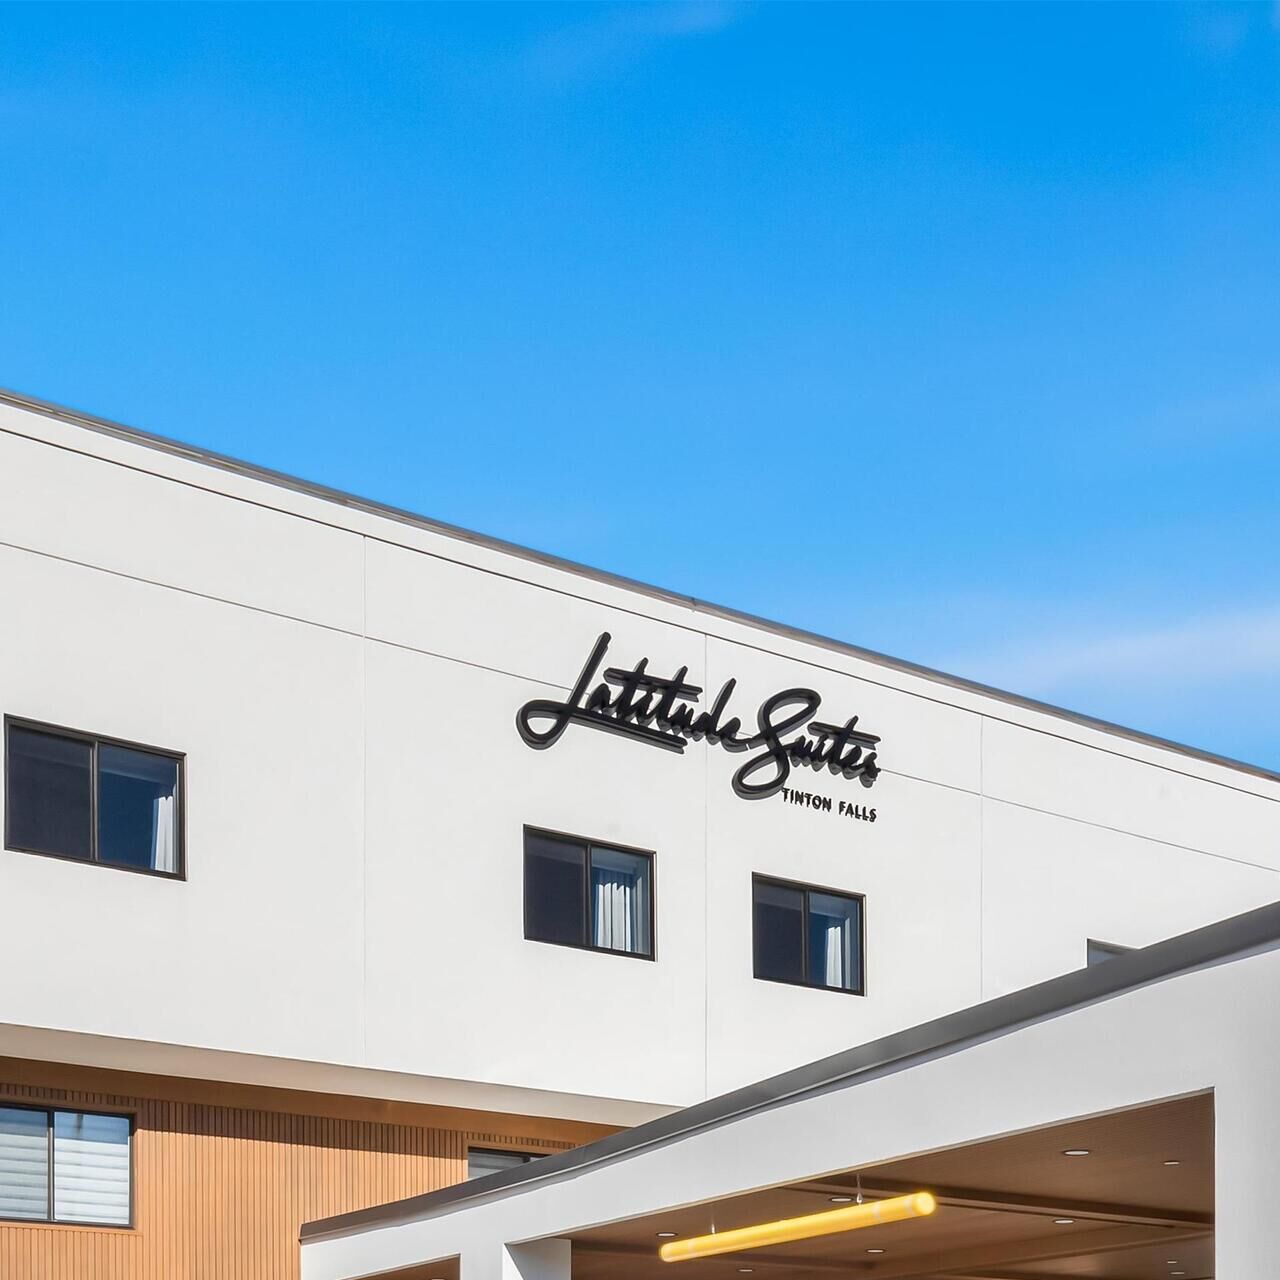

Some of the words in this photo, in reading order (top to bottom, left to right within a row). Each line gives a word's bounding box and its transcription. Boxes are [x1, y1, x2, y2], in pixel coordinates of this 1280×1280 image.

[516, 631, 751, 754] Latitude
[732, 688, 881, 800] Suites
[782, 787, 832, 812] TINTON
[839, 801, 877, 822] FALLS
